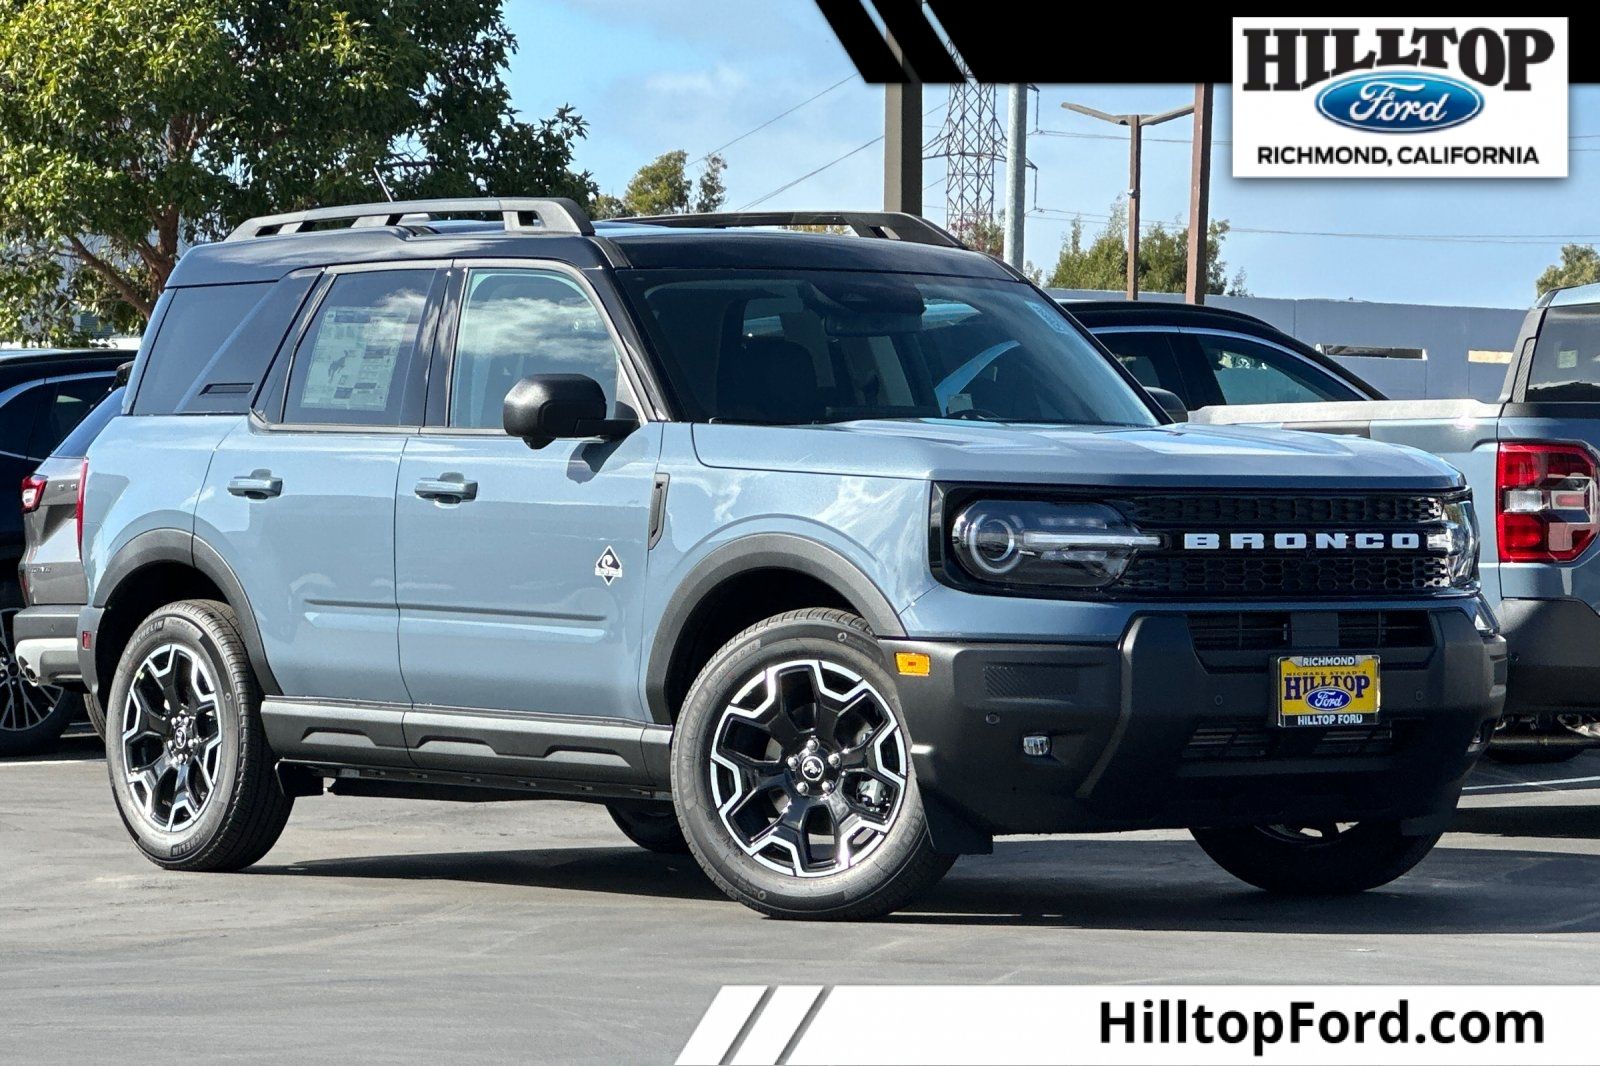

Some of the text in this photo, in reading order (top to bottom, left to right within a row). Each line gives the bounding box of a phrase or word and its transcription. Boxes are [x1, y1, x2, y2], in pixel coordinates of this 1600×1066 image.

[1183, 532, 1420, 550] BRONCO
[1303, 656, 1354, 666] RICHMOND
[1284, 675, 1370, 700] HILLTOP
[1314, 691, 1343, 707] Ford
[1297, 714, 1363, 725] HILLTOP FORD
